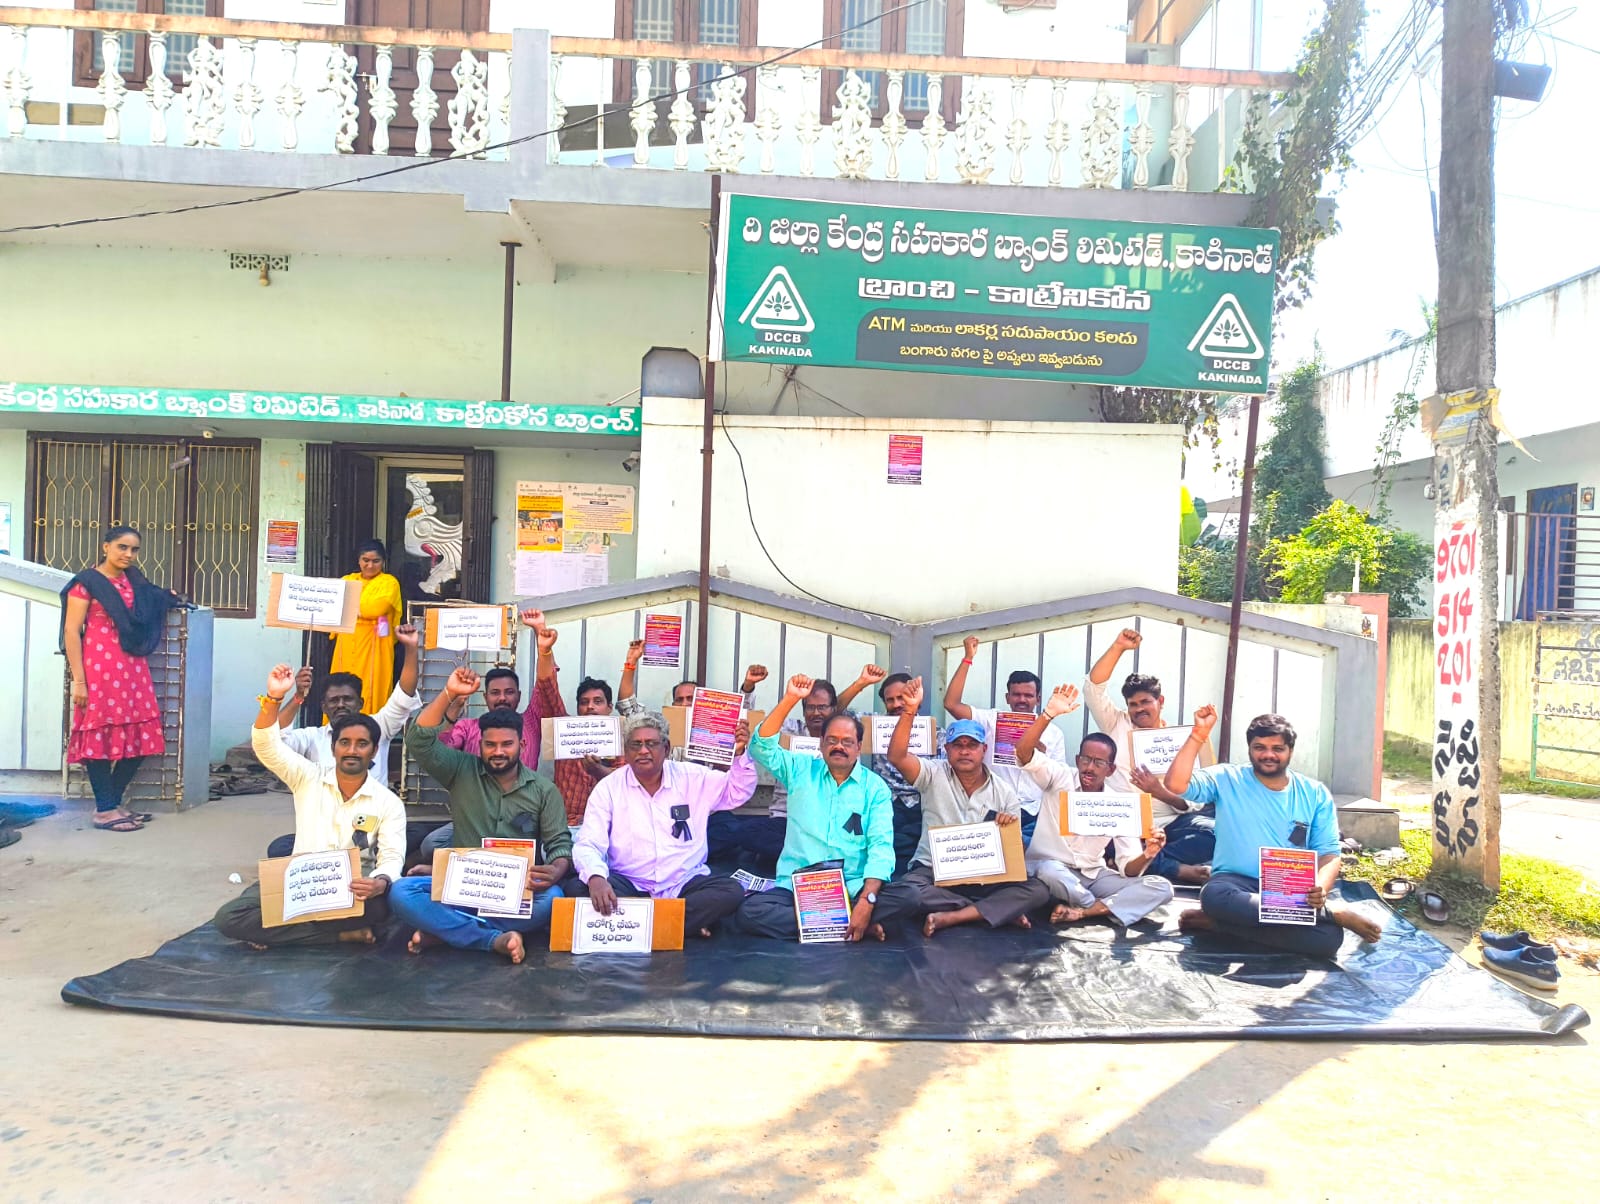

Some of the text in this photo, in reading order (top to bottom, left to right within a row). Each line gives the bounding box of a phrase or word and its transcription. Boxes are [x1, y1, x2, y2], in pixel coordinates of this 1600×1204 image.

[742, 216, 763, 244] ది
[768, 217, 820, 255] జిల్లా
[826, 213, 885, 263] కేంద్ర
[890, 220, 989, 259] సహకార
[994, 228, 1069, 273] బ్యాంక్
[857, 276, 956, 300] బ్రాంచి
[987, 281, 1151, 312] కాట్రేనికోన
[763, 331, 802, 344] DCCB
[867, 315, 906, 332] ATM
[910, 323, 952, 335] మరియు
[1001, 326, 1091, 343] సదుపాయం
[1094, 330, 1138, 345] కలదు
[748, 344, 813, 358] KAKINADA
[899, 344, 1103, 369] బంగారు నగల పై అప్పులు ఇవ్వబడును
[1212, 358, 1251, 371] DCCB
[1197, 371, 1263, 385] KAKINADA
[63, 387, 159, 412] సహకార
[165, 392, 248, 418] బ్యాంక్
[435, 400, 548, 429] కాట్రేనికోన
[1437, 528, 1477, 583] 9701
[1437, 587, 1473, 637] 514
[1437, 639, 1472, 685] 201
